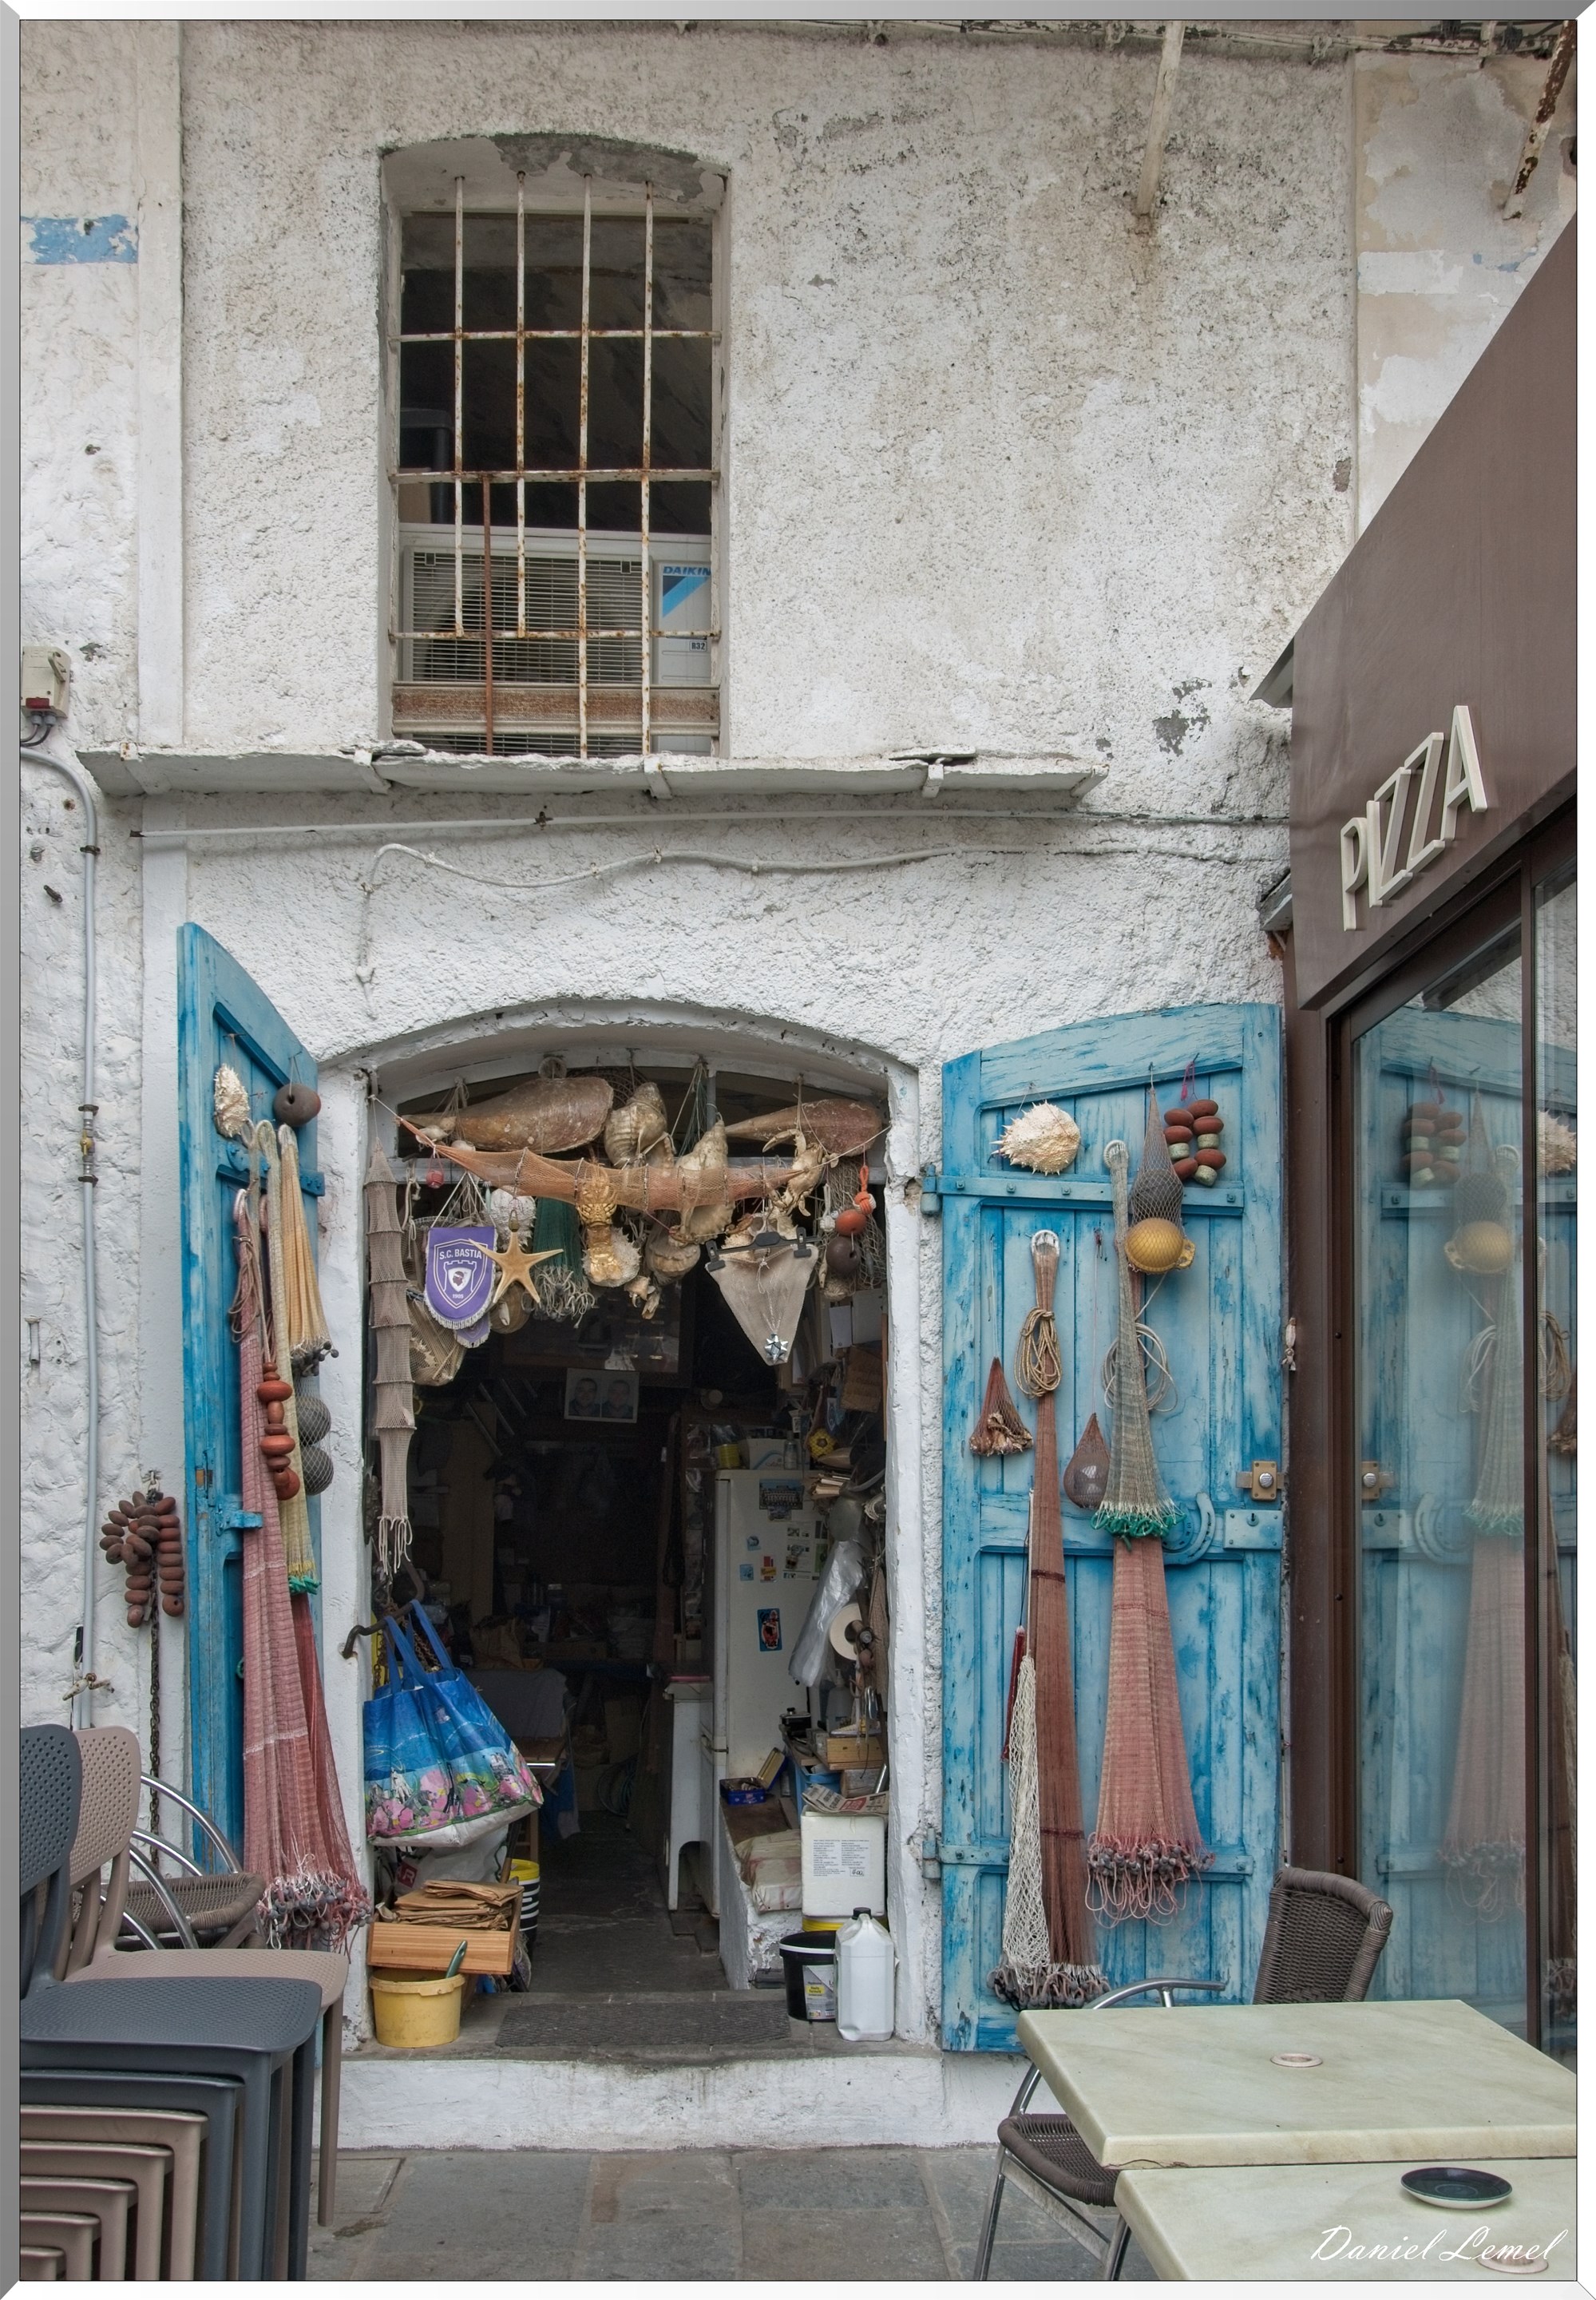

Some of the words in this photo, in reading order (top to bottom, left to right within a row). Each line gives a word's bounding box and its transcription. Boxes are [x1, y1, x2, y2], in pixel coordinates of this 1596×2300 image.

[663, 566, 711, 576] DAIKIN
[1341, 705, 1487, 931] PIZZA
[439, 1250, 453, 1259] S.C.
[454, 1248, 482, 1259] BASTIA
